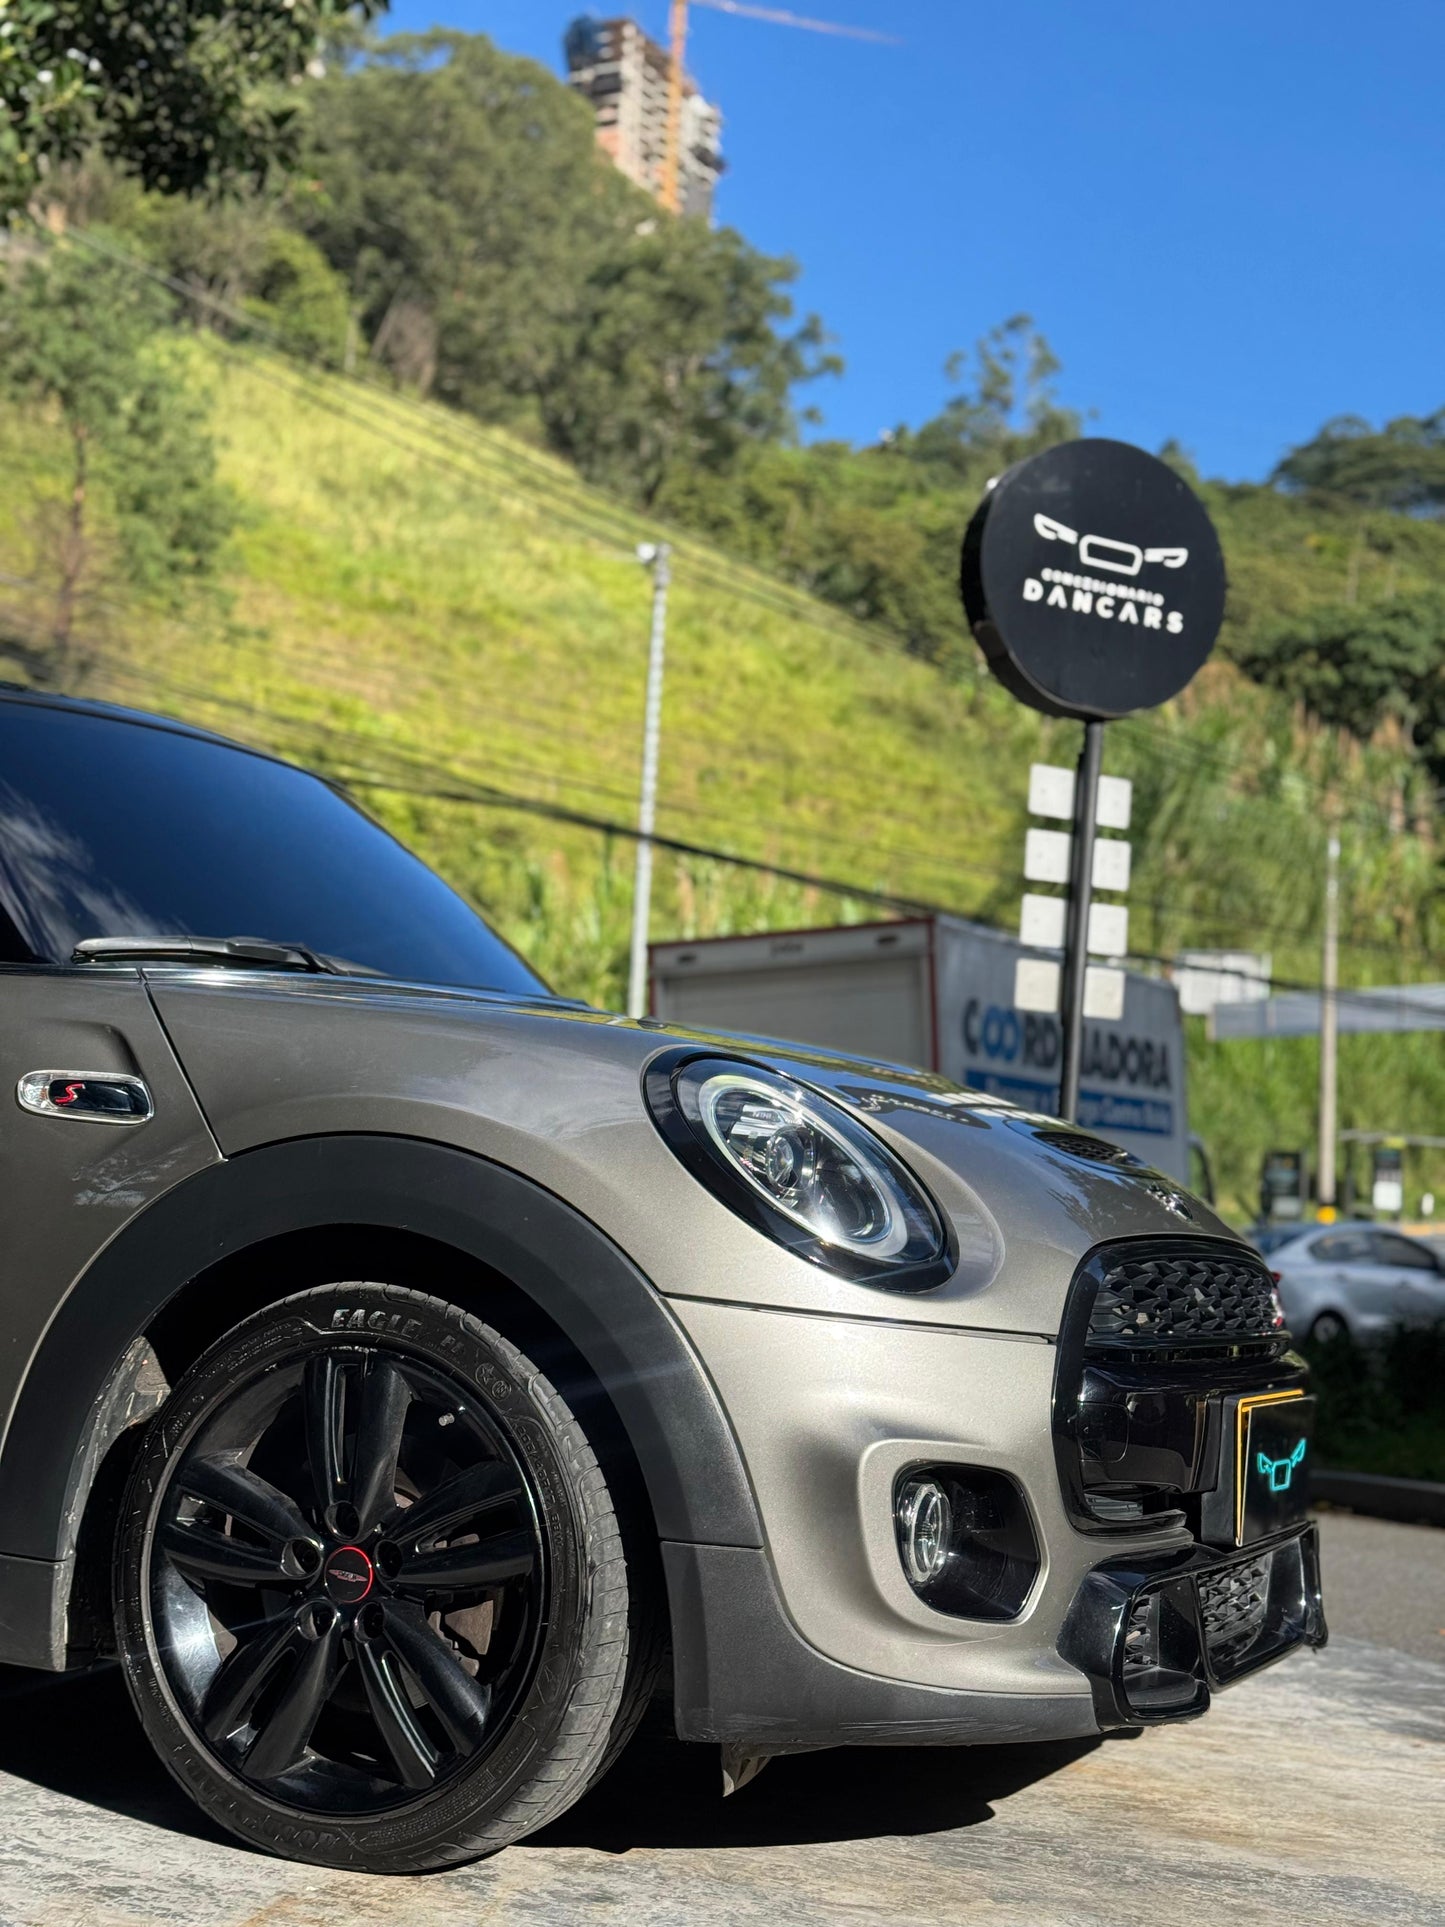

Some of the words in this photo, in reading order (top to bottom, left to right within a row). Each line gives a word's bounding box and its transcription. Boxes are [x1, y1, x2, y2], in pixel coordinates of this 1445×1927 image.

[1023, 578, 1183, 634] DANCARS
[963, 997, 1171, 1089] COORDADORA
[55, 1083, 86, 1105] S
[331, 1308, 423, 1338] EAGLE
